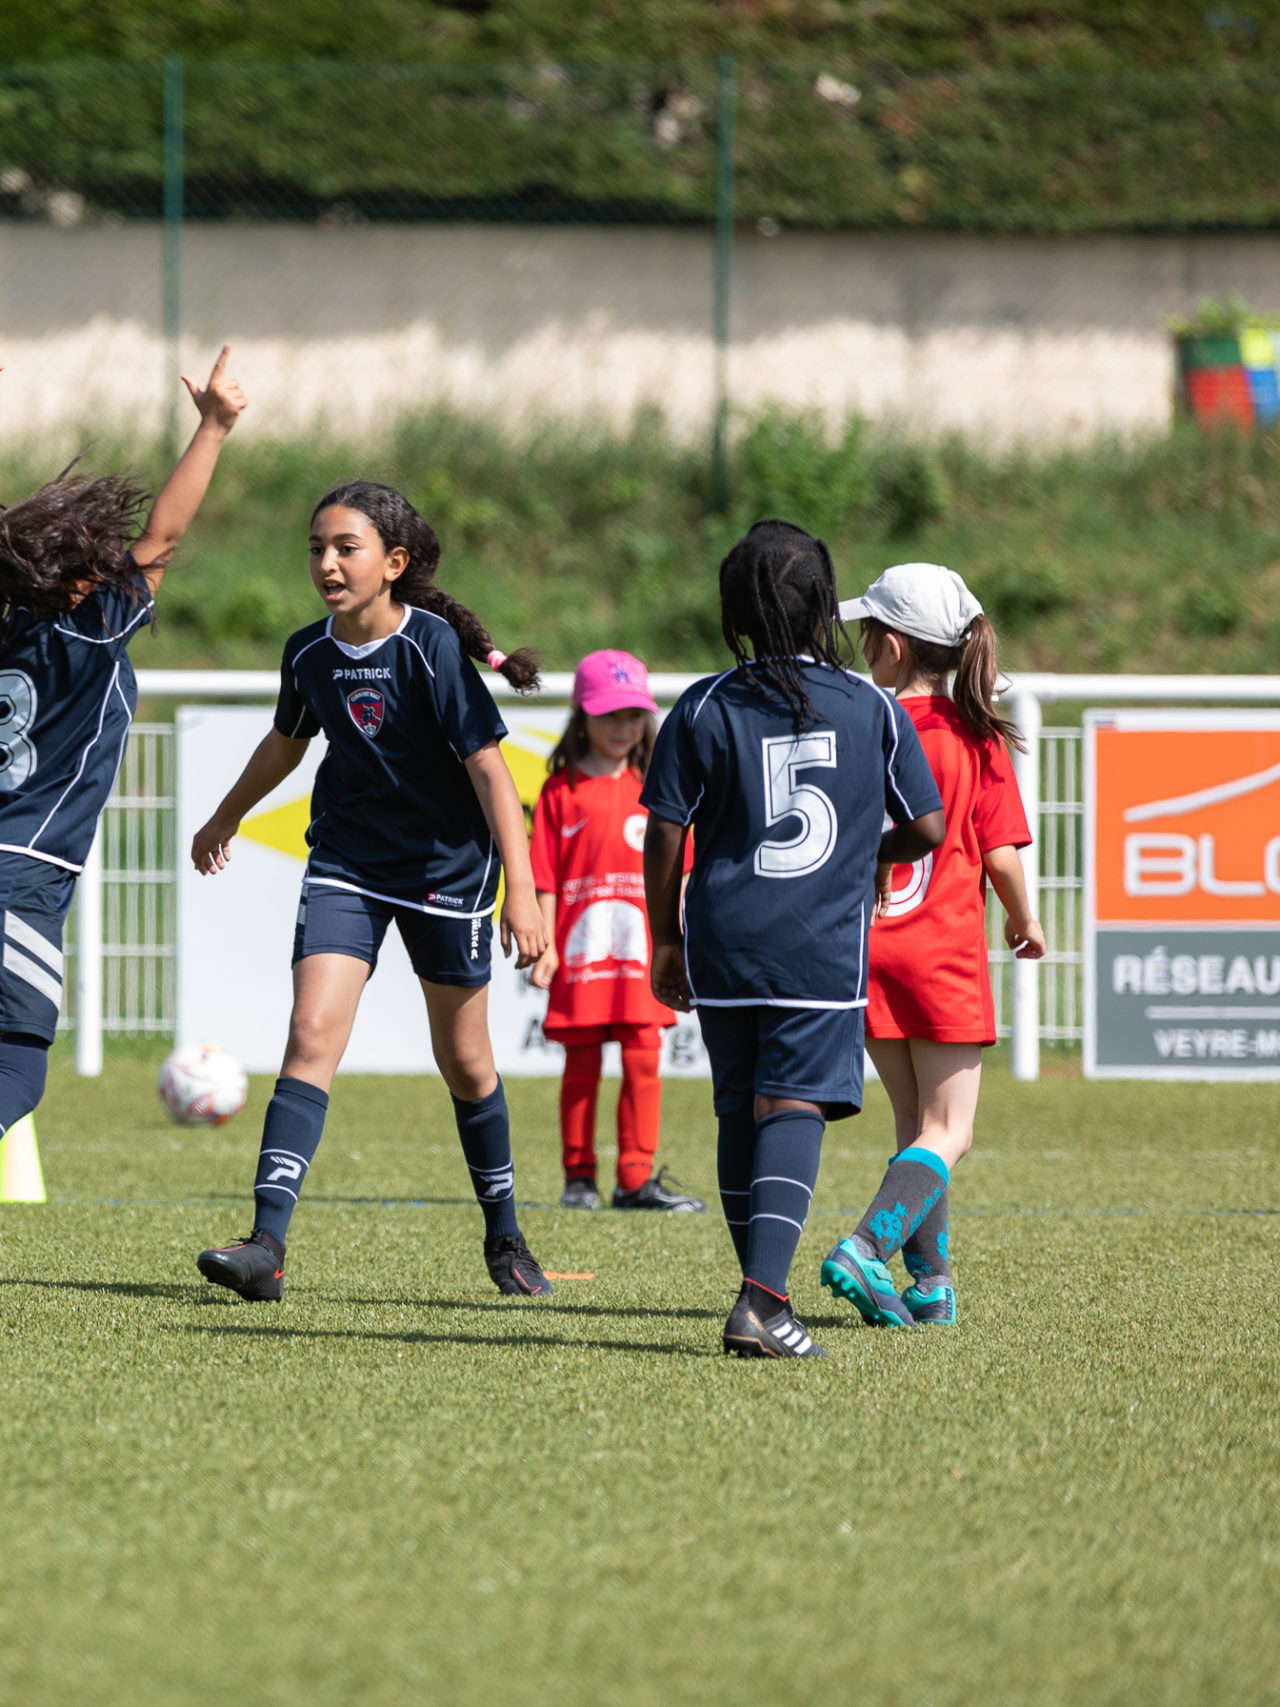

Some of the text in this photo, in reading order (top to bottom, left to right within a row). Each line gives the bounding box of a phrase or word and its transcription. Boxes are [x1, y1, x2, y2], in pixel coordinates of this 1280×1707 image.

[344, 667, 392, 680] PATRICK
[754, 731, 838, 878] 5
[1123, 832, 1280, 897] BL
[1152, 1028, 1280, 1058] VEYRE-M
